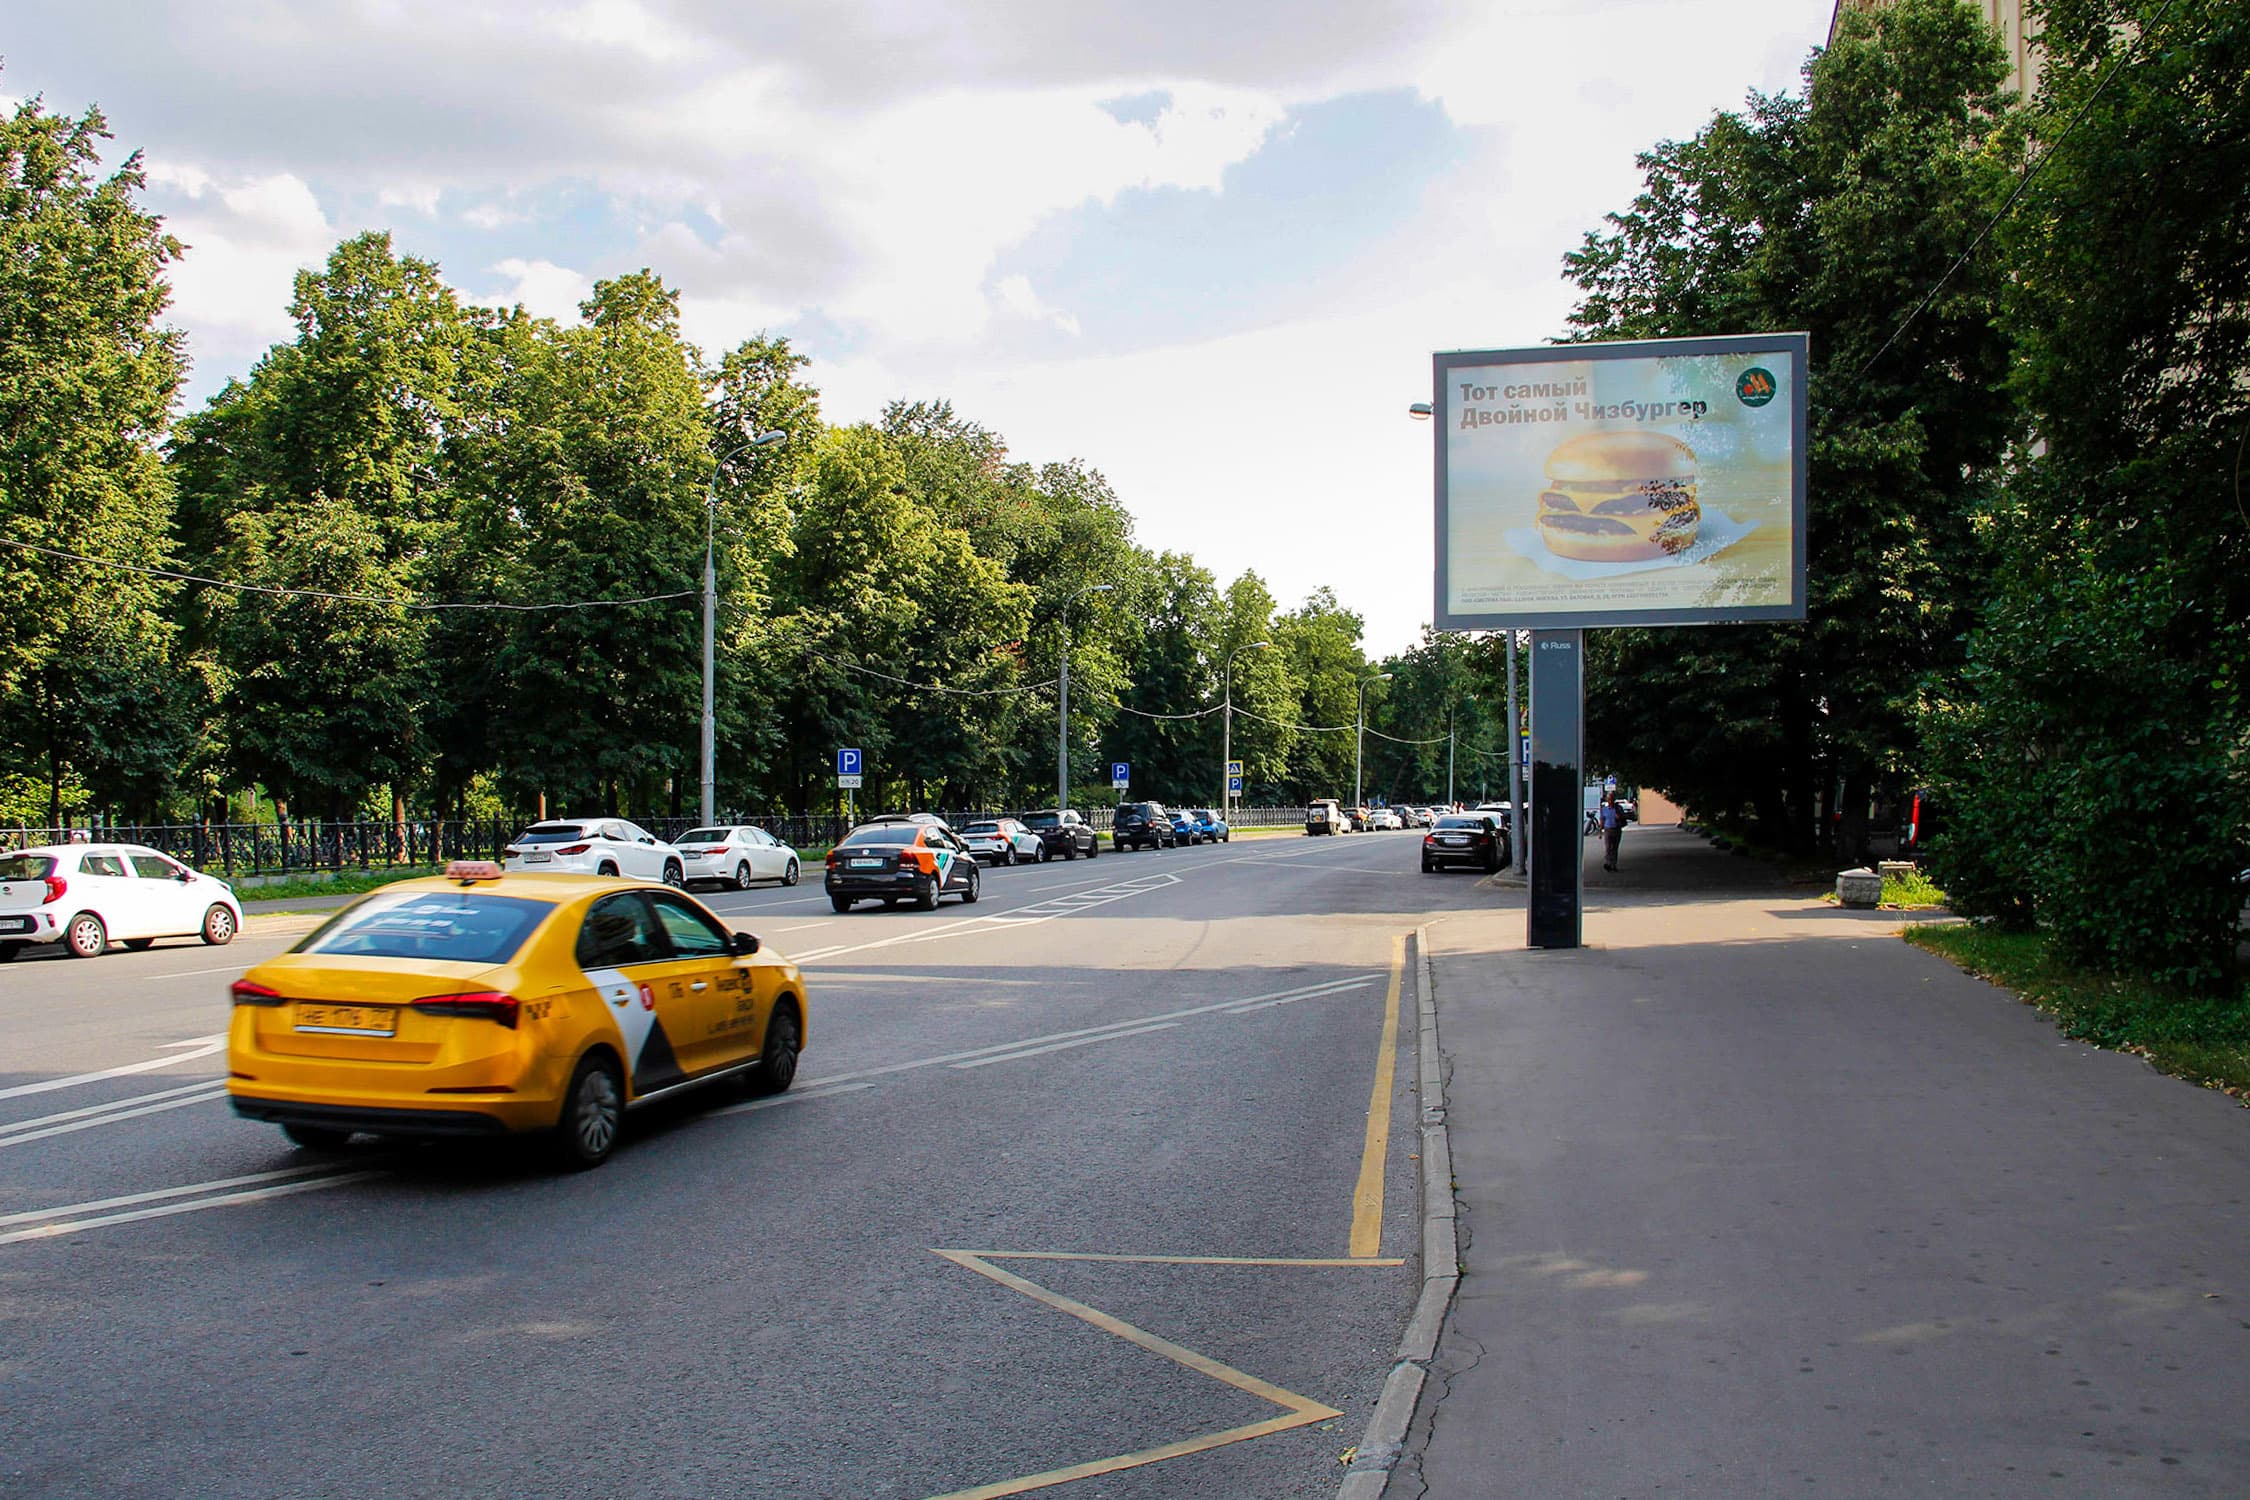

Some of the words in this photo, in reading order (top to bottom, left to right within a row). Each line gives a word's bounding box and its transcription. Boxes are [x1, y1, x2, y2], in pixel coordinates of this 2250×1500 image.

[1460, 383, 1498, 402] Тот
[1503, 376, 1587, 399] самый
[1460, 402, 1568, 430] Двойной
[1574, 399, 1708, 422] Чизбургер
[844, 752, 857, 771] P
[1116, 765, 1126, 778] P
